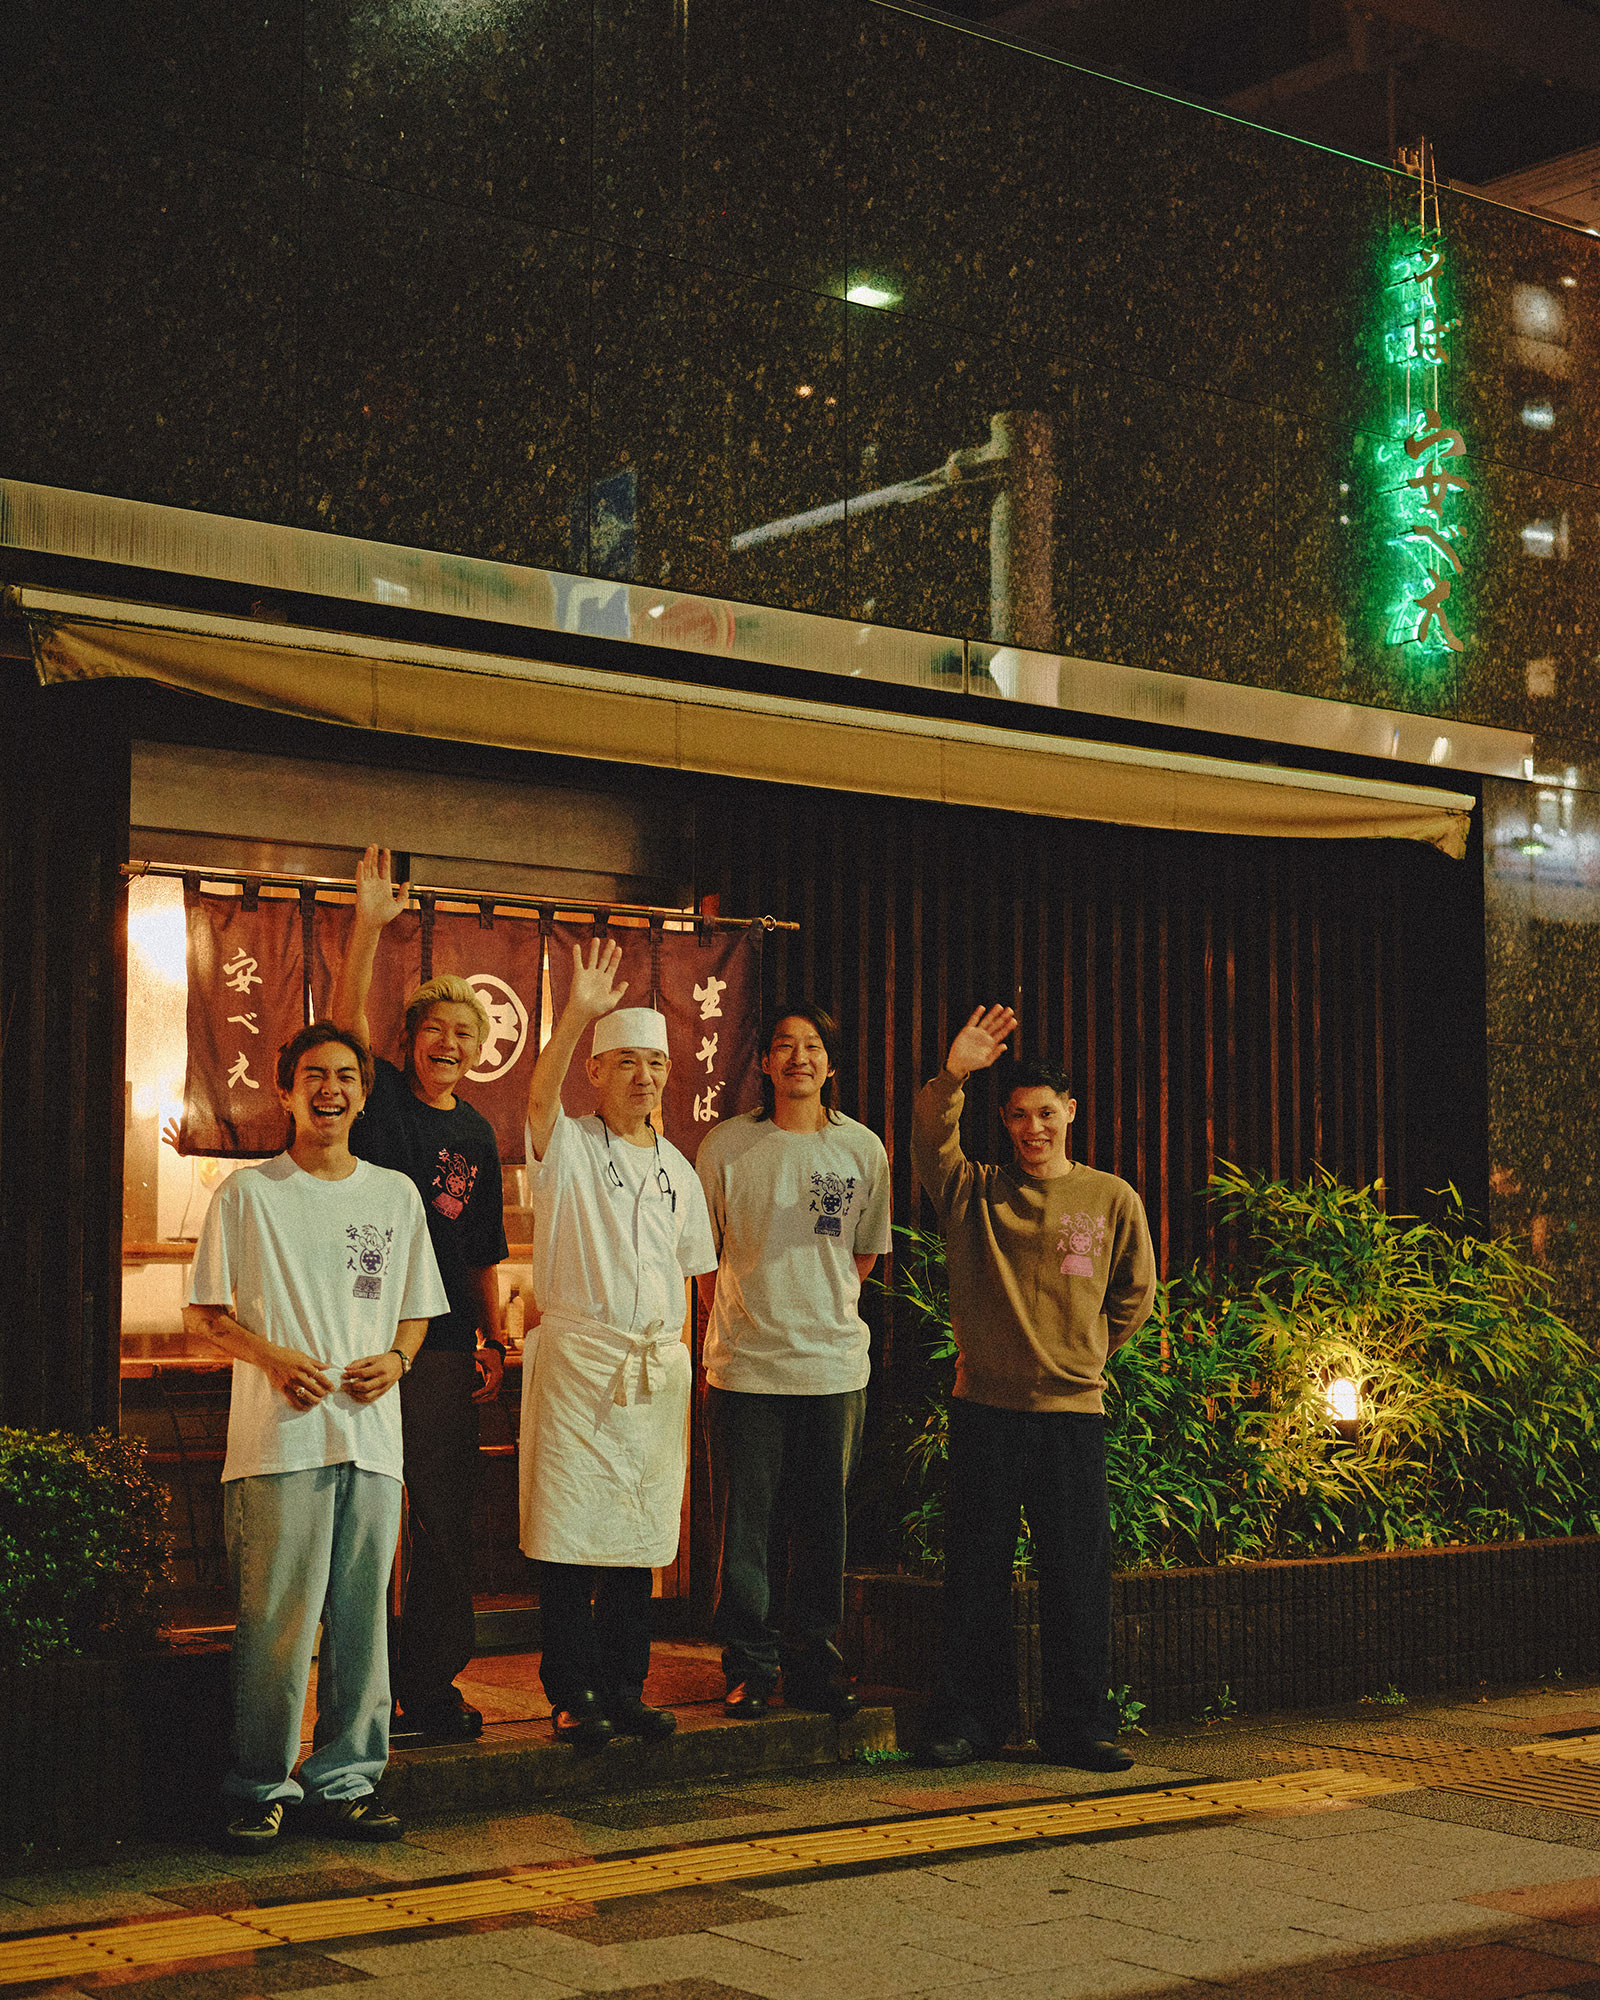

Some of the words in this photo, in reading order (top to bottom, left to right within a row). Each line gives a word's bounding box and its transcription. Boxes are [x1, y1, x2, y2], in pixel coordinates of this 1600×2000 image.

[1414, 248, 1462, 364] そば
[692, 976, 728, 1123] 生そば
